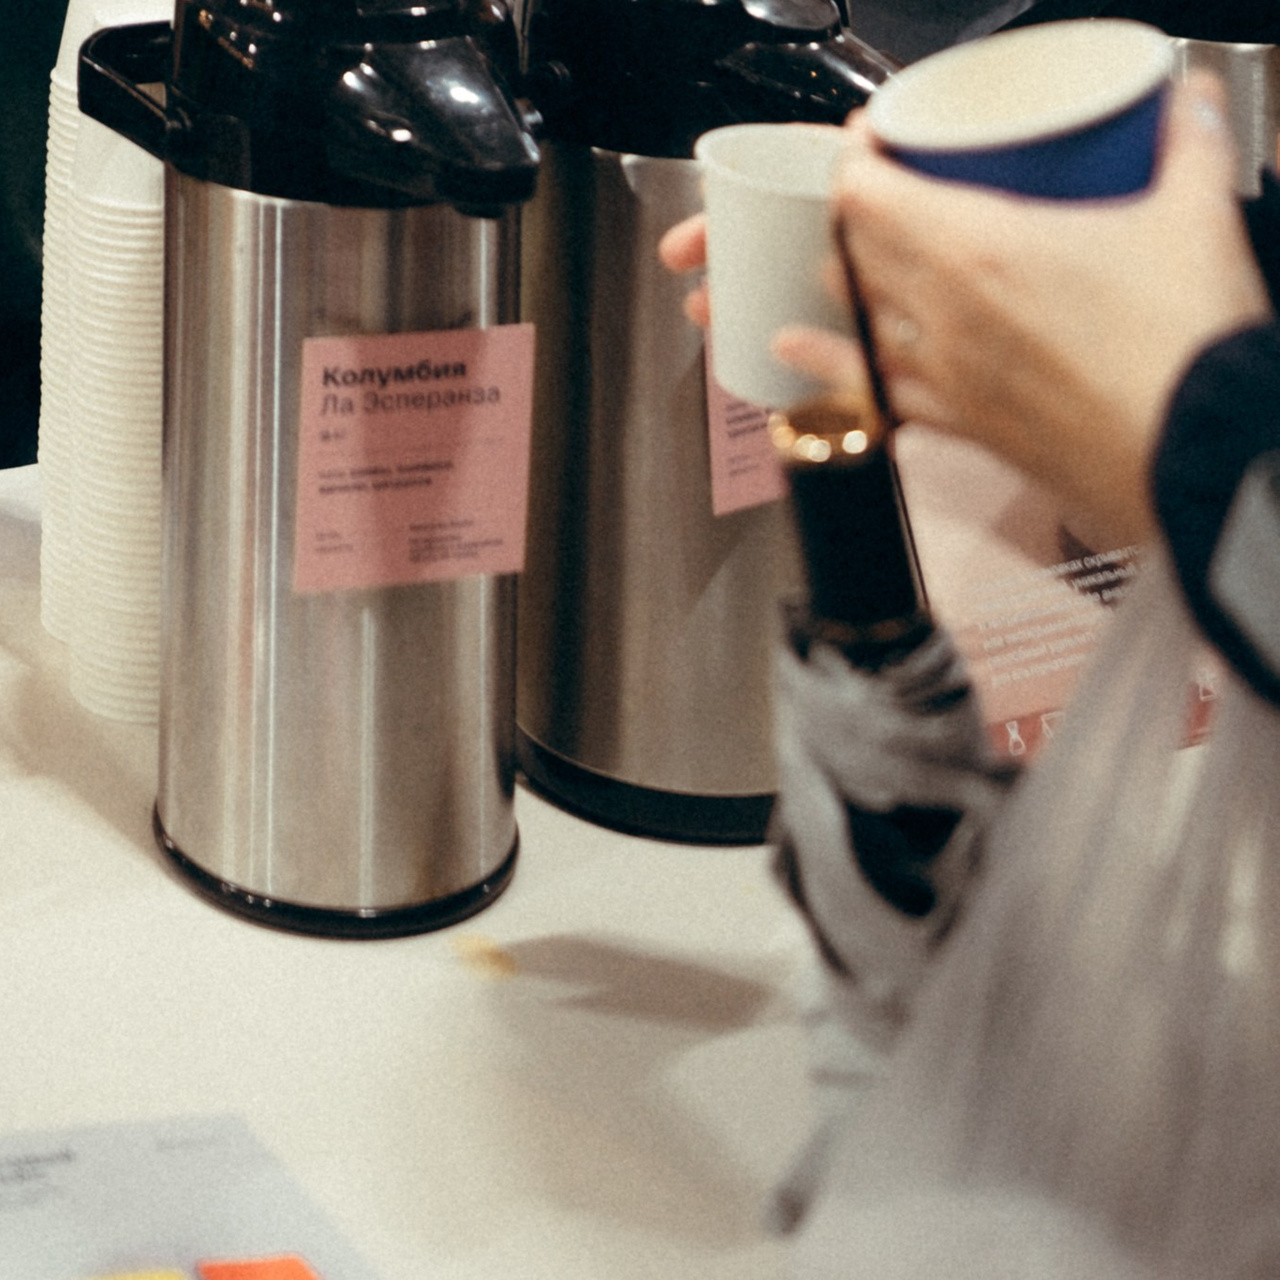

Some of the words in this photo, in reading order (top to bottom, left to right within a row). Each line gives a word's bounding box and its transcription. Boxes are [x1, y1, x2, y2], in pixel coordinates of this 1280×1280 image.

[322, 359, 467, 388] Колумбия
[322, 393, 354, 416] Ла
[363, 385, 501, 414] Эсперанза
